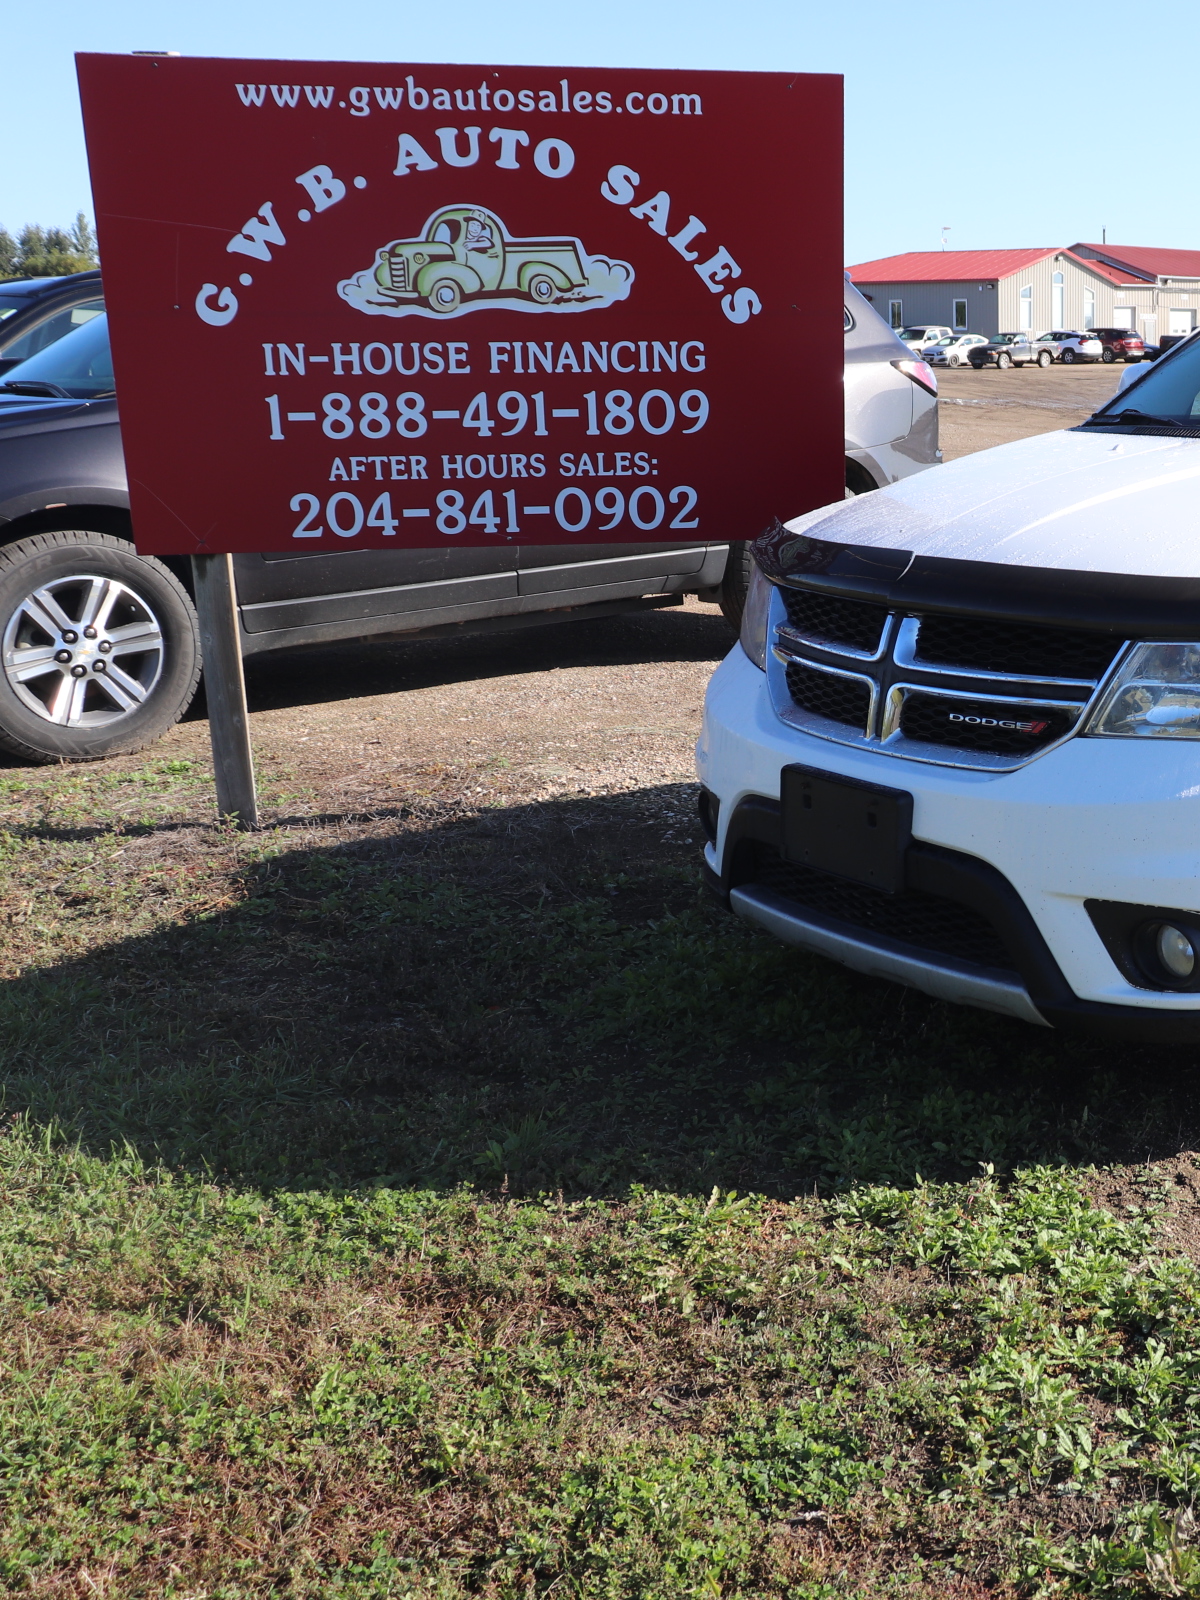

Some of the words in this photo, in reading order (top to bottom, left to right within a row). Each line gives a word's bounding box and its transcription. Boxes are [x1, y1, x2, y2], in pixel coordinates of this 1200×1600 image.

[235, 76, 703, 117] www.gwbautosales.com
[195, 164, 367, 327] G.W.B.
[393, 126, 575, 179] AUTO
[600, 164, 763, 325] SALES
[262, 341, 471, 377] IN-HOUSE
[488, 341, 706, 375] FINANCING
[265, 389, 710, 440] 1-888-491-1809
[329, 456, 429, 482] AFTER
[441, 454, 546, 480] HOURS
[560, 452, 660, 478] SALES:
[290, 486, 699, 538] 204-841-0902
[949, 713, 1033, 731] DODGE
